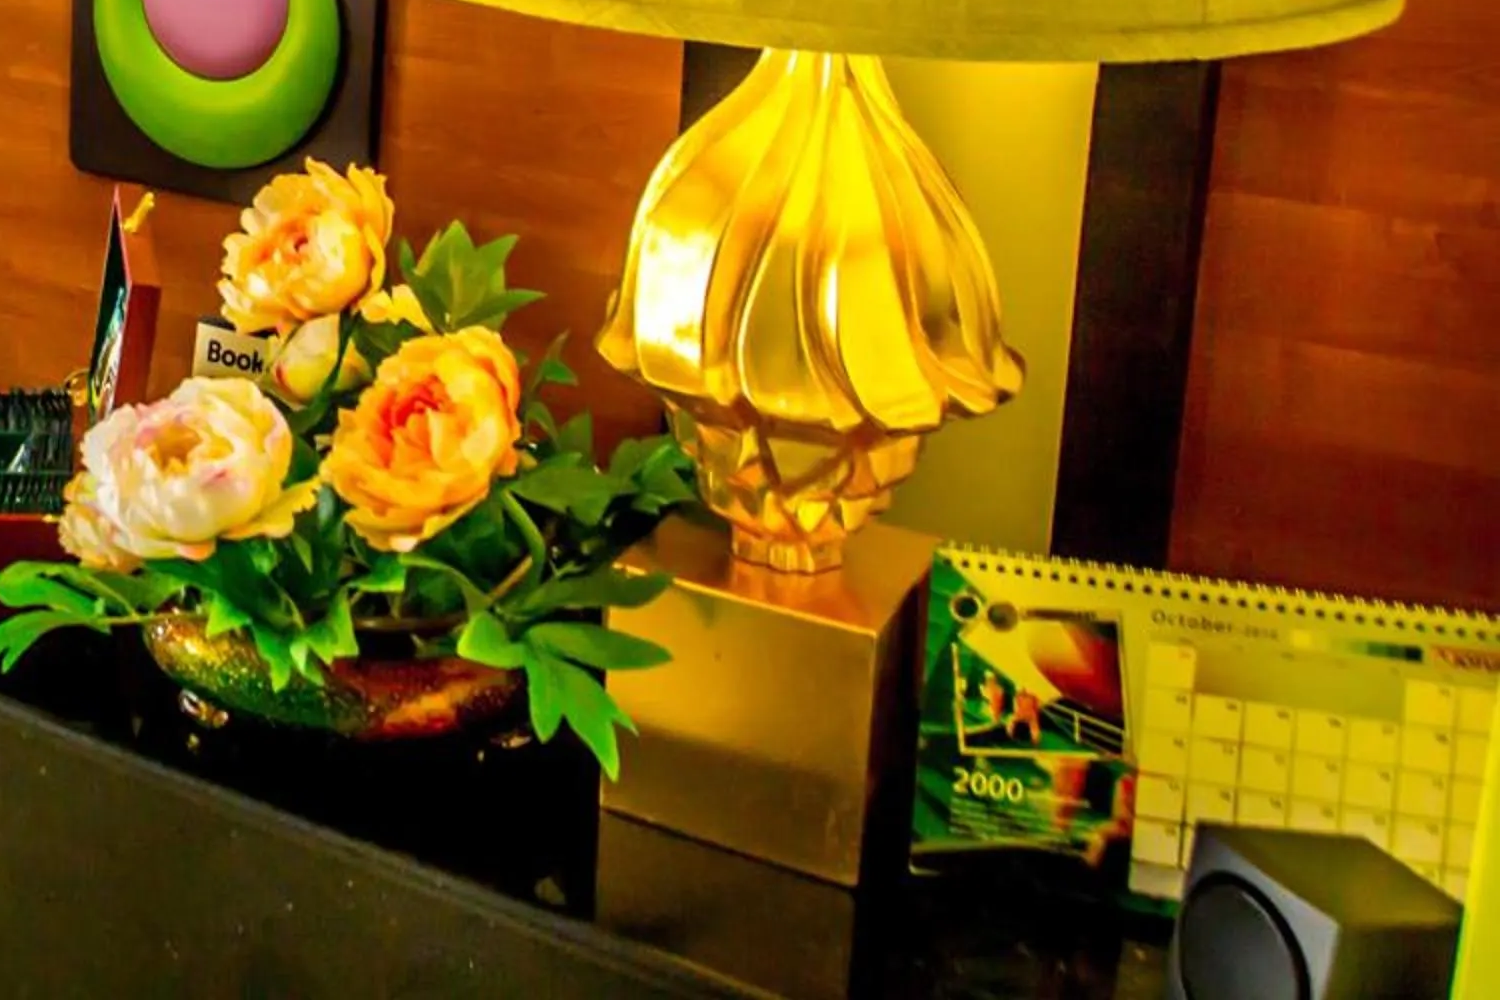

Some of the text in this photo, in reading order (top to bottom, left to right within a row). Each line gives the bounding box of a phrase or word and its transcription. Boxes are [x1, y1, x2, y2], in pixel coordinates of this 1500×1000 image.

[207, 339, 264, 374] Book
[1152, 609, 1232, 633] October
[953, 767, 1023, 803] 2000
